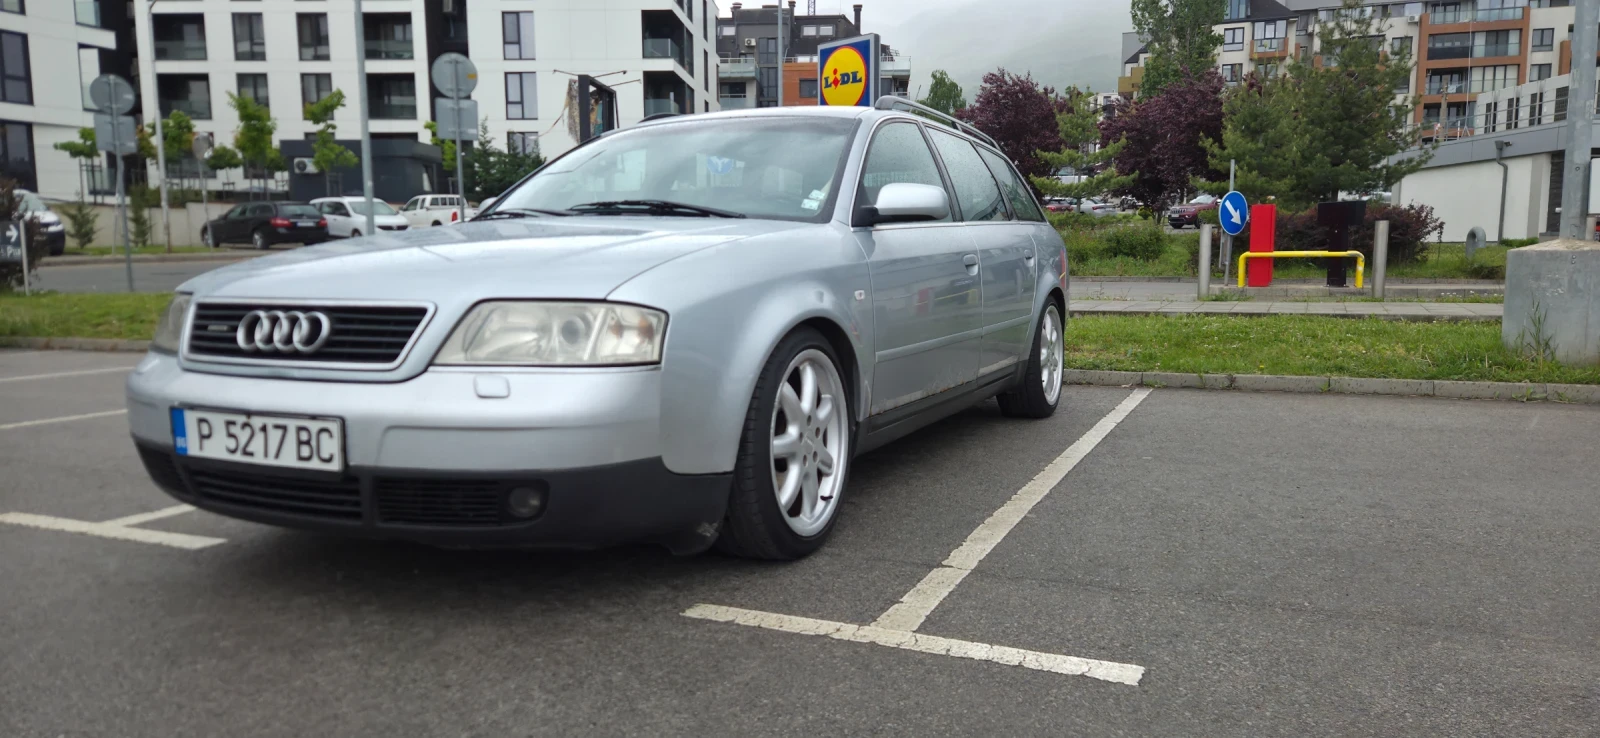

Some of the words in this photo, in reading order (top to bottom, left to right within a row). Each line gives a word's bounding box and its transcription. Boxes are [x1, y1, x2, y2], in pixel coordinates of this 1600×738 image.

[197, 418, 213, 452] P
[224, 419, 288, 460] 5217
[295, 425, 334, 464] BC
